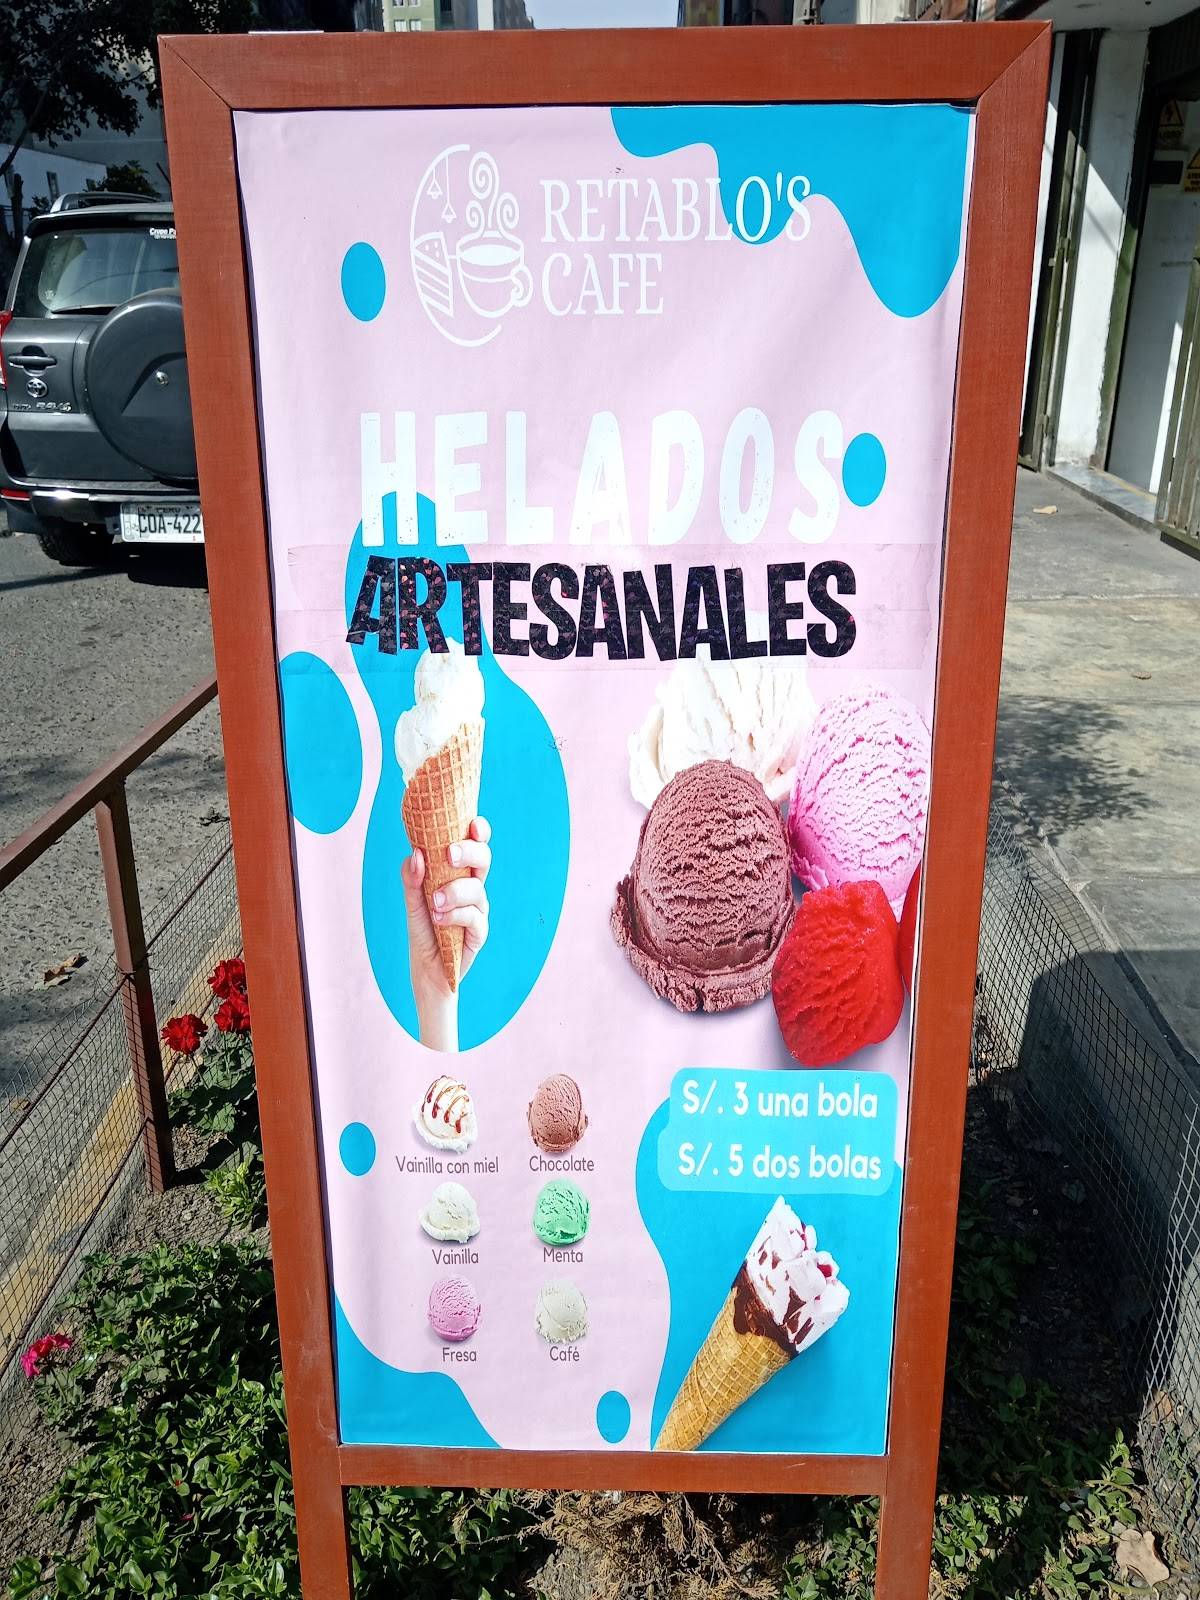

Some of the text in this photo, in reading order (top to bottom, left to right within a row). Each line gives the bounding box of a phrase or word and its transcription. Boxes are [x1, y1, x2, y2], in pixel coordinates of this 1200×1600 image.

[539, 172, 812, 243] RETABLO'S
[541, 252, 664, 317] CAFE
[360, 407, 845, 547] HELADOS
[346, 555, 857, 662] ARTESANALES
[733, 1081, 749, 1116] 3
[757, 1091, 809, 1117] una
[817, 1082, 878, 1118] bola
[395, 1156, 499, 1174] Vainilla con miel
[528, 1155, 595, 1172] Chocolate
[728, 1143, 744, 1177] 5
[752, 1145, 800, 1179] dos
[809, 1144, 882, 1181] bolas
[432, 1248, 479, 1265] Vainilla
[543, 1247, 584, 1263] Menta
[442, 1347, 477, 1362] Fresa
[549, 1345, 580, 1362] Café
